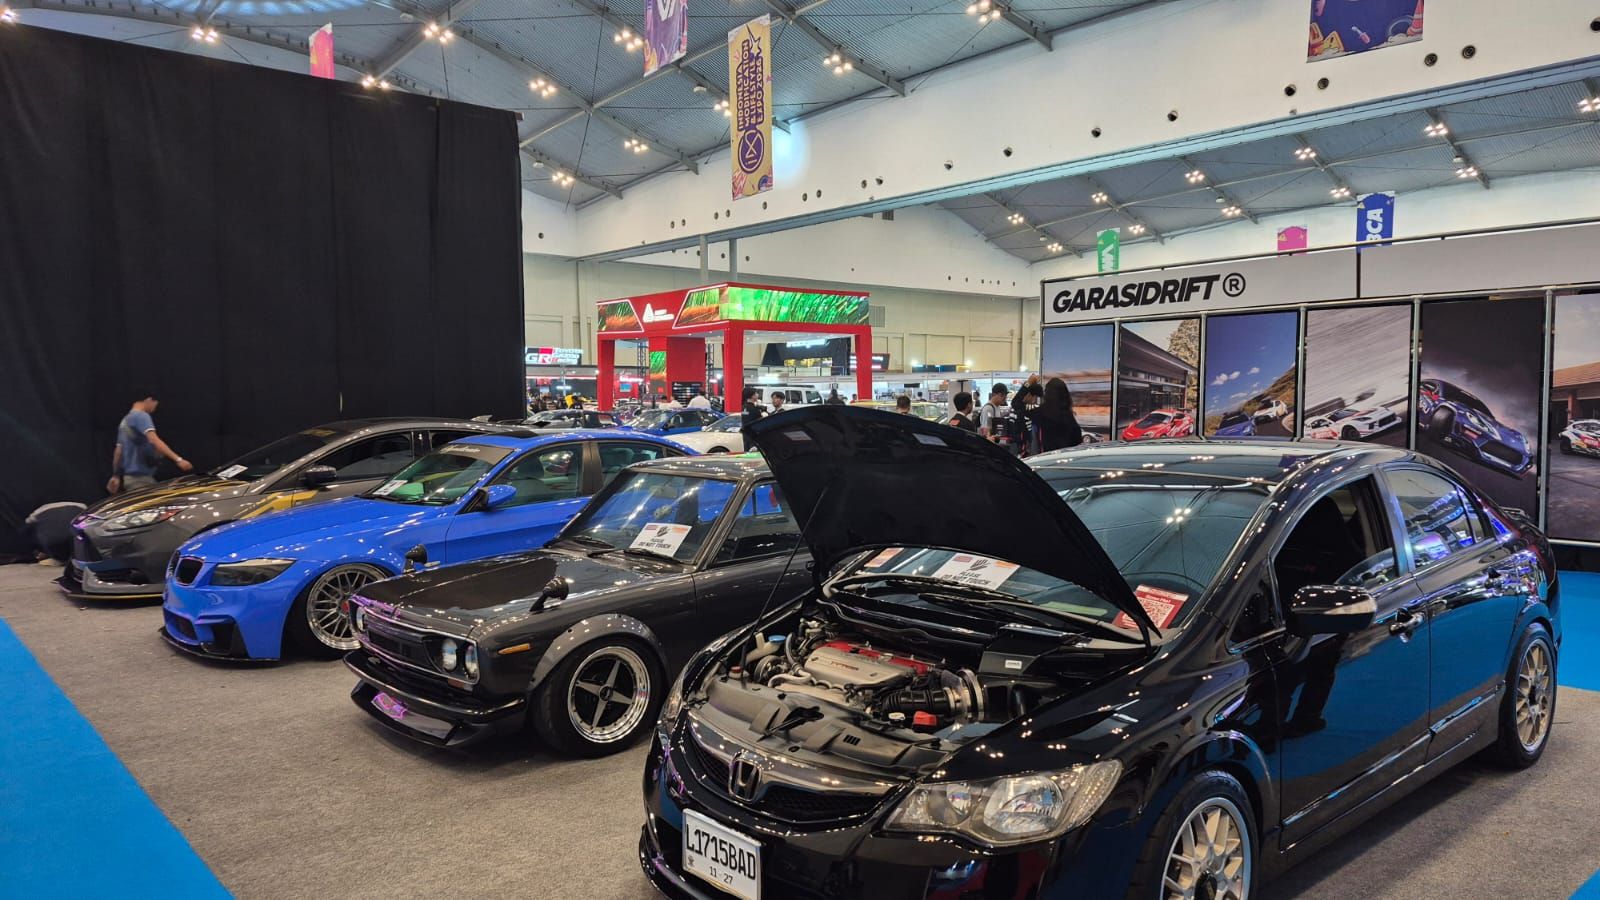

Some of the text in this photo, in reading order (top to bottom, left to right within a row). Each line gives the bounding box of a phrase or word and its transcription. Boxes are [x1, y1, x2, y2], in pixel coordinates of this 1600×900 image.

[742, 41, 750, 128] MODIFICATION
[1052, 274, 1221, 313] GARASIDRIFT
[525, 352, 552, 365] GR
[686, 823, 756, 881] L1715BAD
